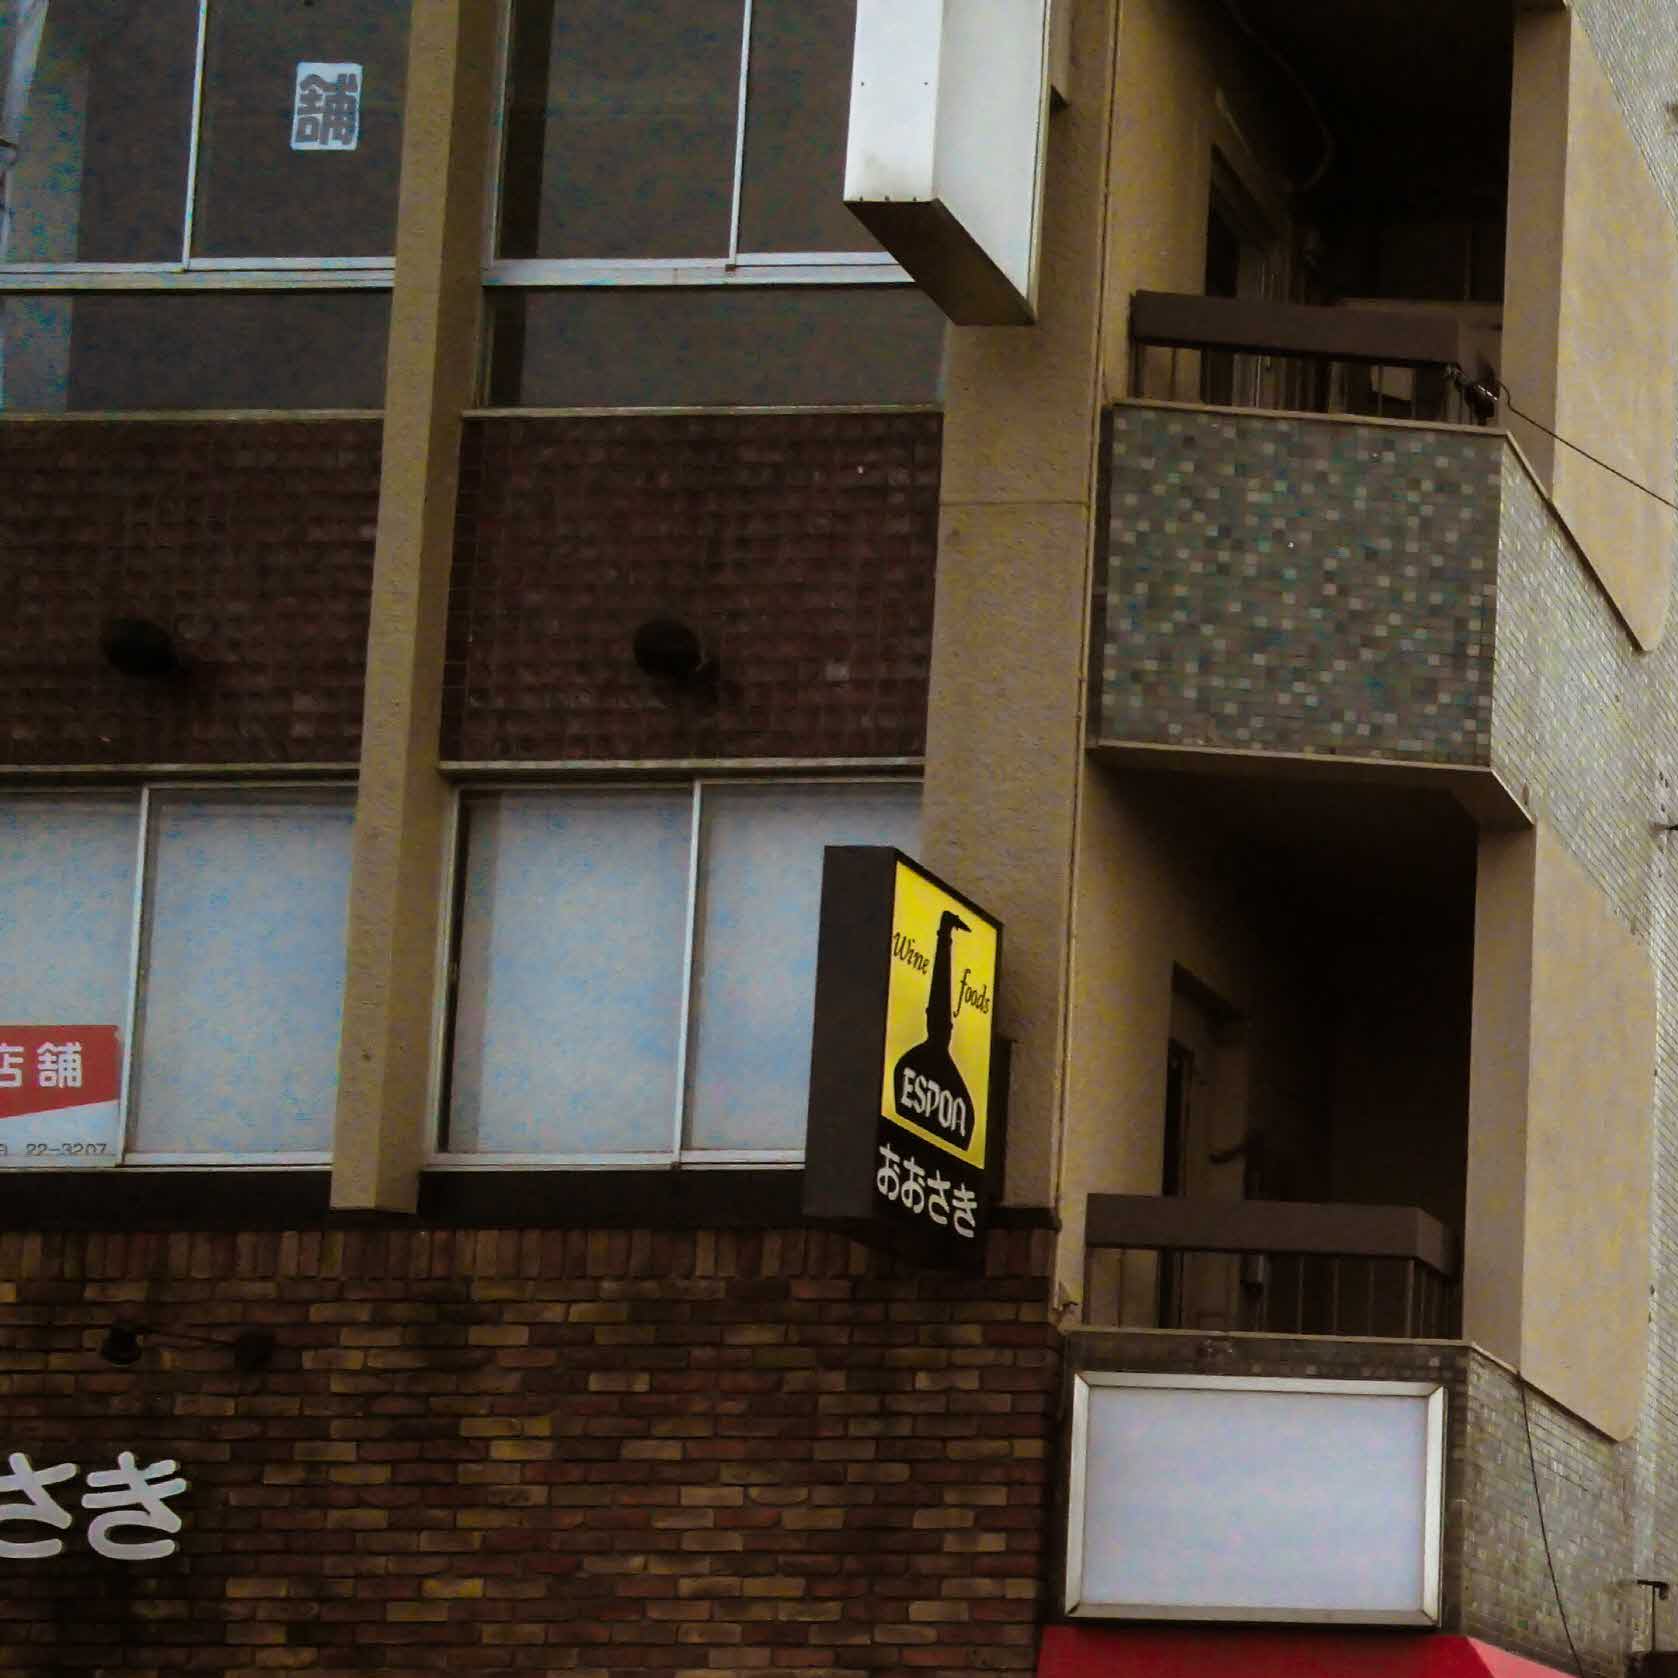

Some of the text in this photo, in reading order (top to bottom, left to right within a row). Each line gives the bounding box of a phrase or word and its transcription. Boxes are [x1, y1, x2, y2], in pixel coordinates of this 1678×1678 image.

[893, 932, 928, 974] Wine
[954, 968, 990, 1016] foods
[901, 1067, 966, 1137] ESPOA
[876, 1143, 977, 1238] おおさき
[0, 1451, 187, 1560] さき
